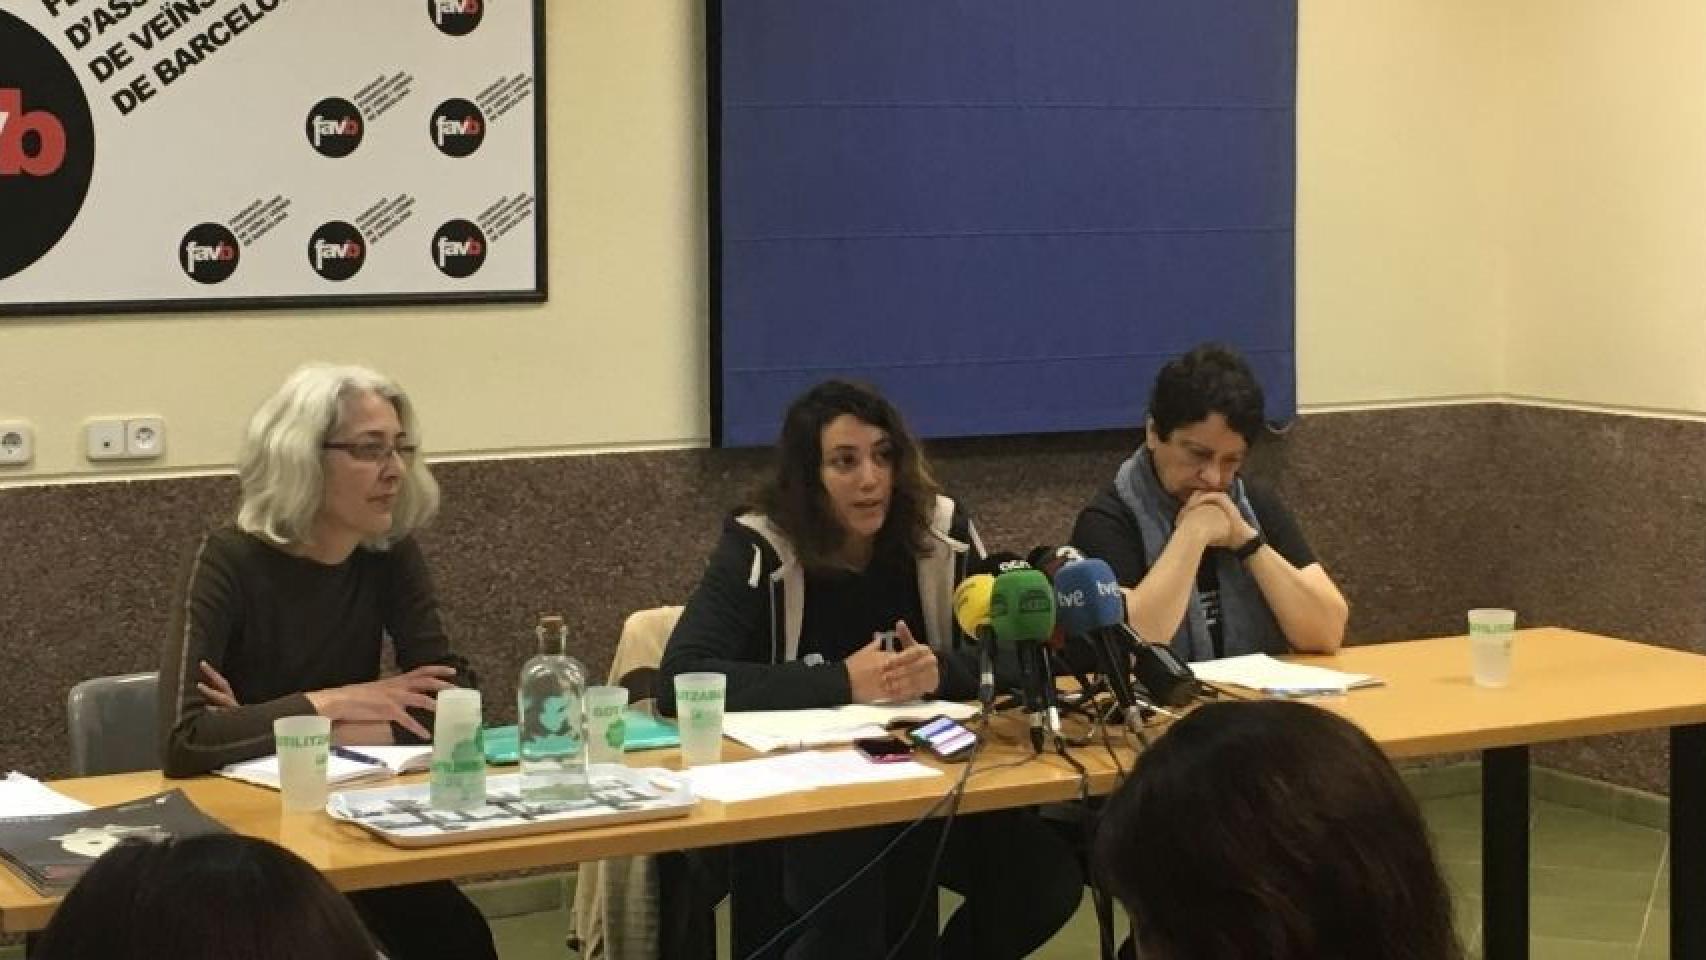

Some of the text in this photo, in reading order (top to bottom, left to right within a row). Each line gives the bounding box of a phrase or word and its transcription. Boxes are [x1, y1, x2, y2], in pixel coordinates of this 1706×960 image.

[88, 42, 134, 83] DE
[111, 74, 157, 116] DE
[312, 115, 359, 146] favb
[436, 115, 480, 146] favb
[186, 241, 233, 273] favb
[314, 239, 361, 270] favb
[438, 236, 481, 267] favb
[1057, 589, 1084, 607] tve
